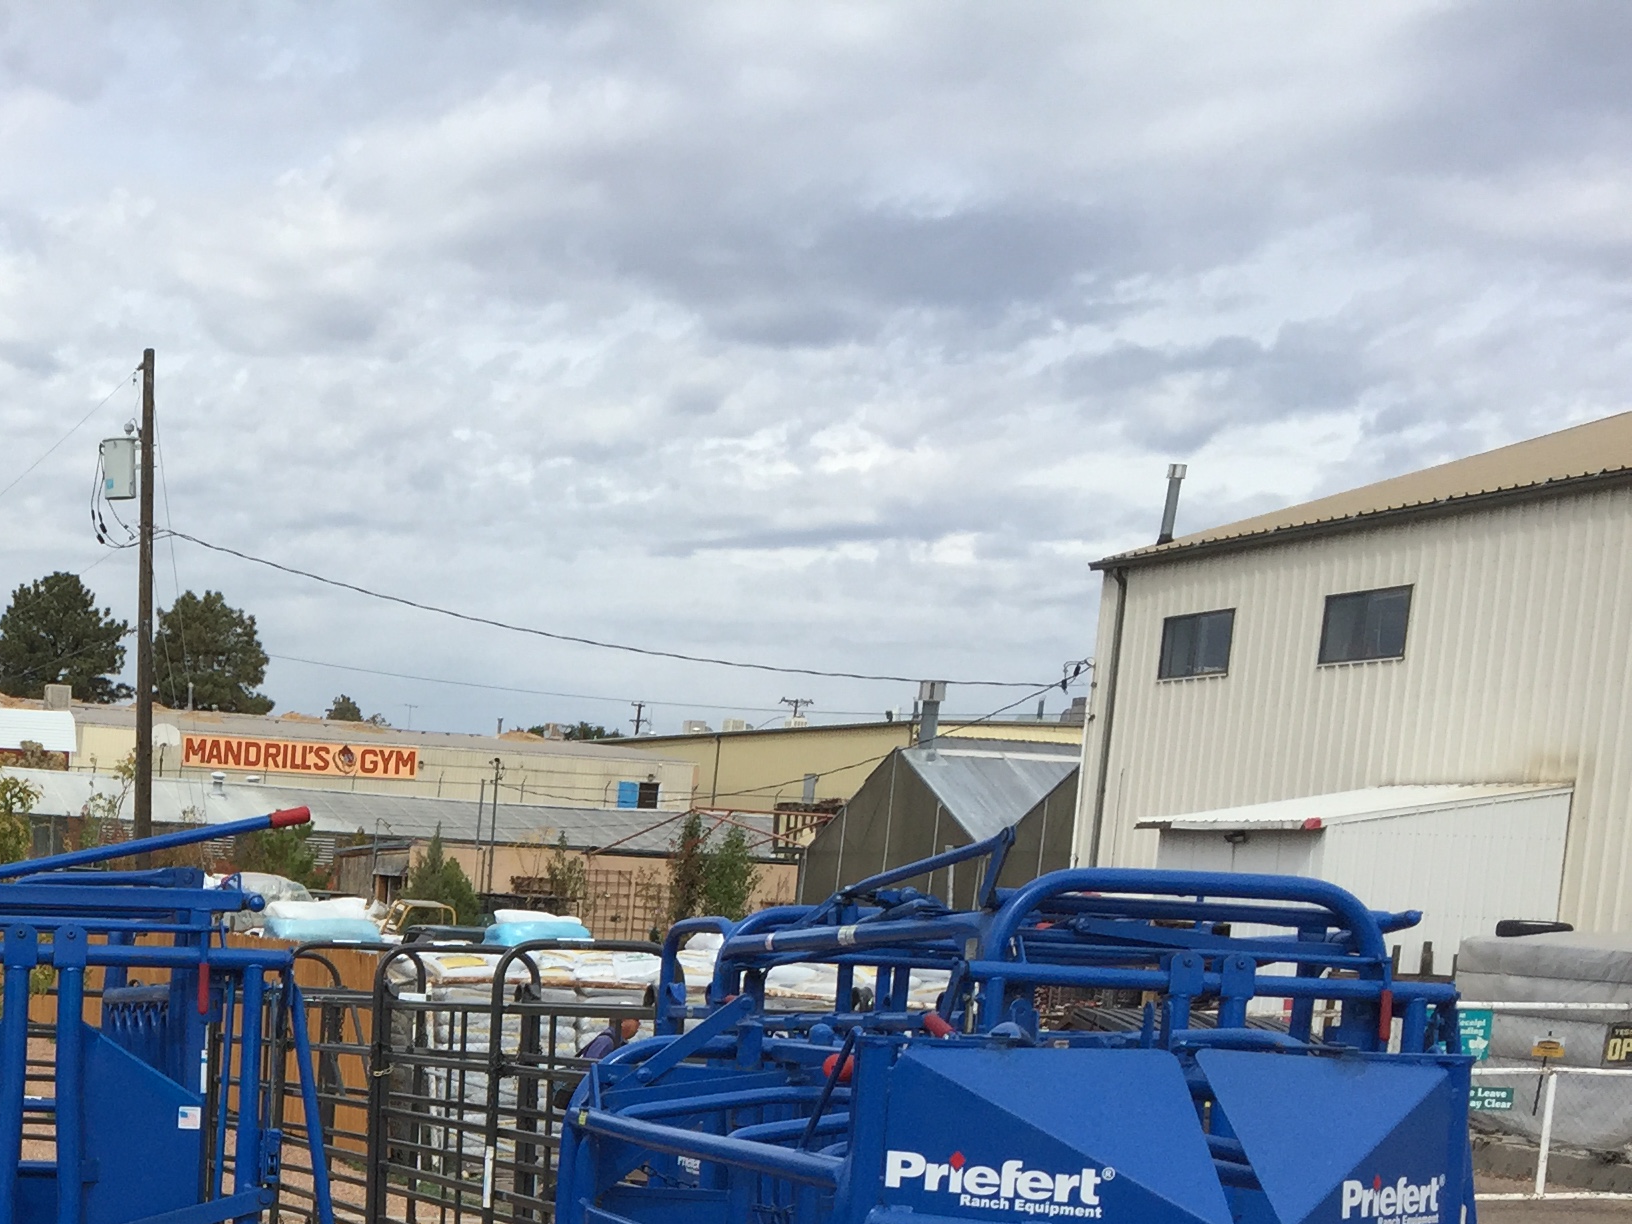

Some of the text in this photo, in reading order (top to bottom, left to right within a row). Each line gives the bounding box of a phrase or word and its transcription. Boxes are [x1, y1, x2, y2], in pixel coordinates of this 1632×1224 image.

[184, 737, 417, 776] MANDRILL'S GYM
[1607, 1038, 1632, 1061] OP
[1477, 1087, 1508, 1099] Leave
[1484, 1097, 1512, 1109] Clear
[884, 1150, 1102, 1206] Priefert
[959, 1194, 1103, 1219] Ranch Equipment
[1341, 1175, 1440, 1220] Priefert
